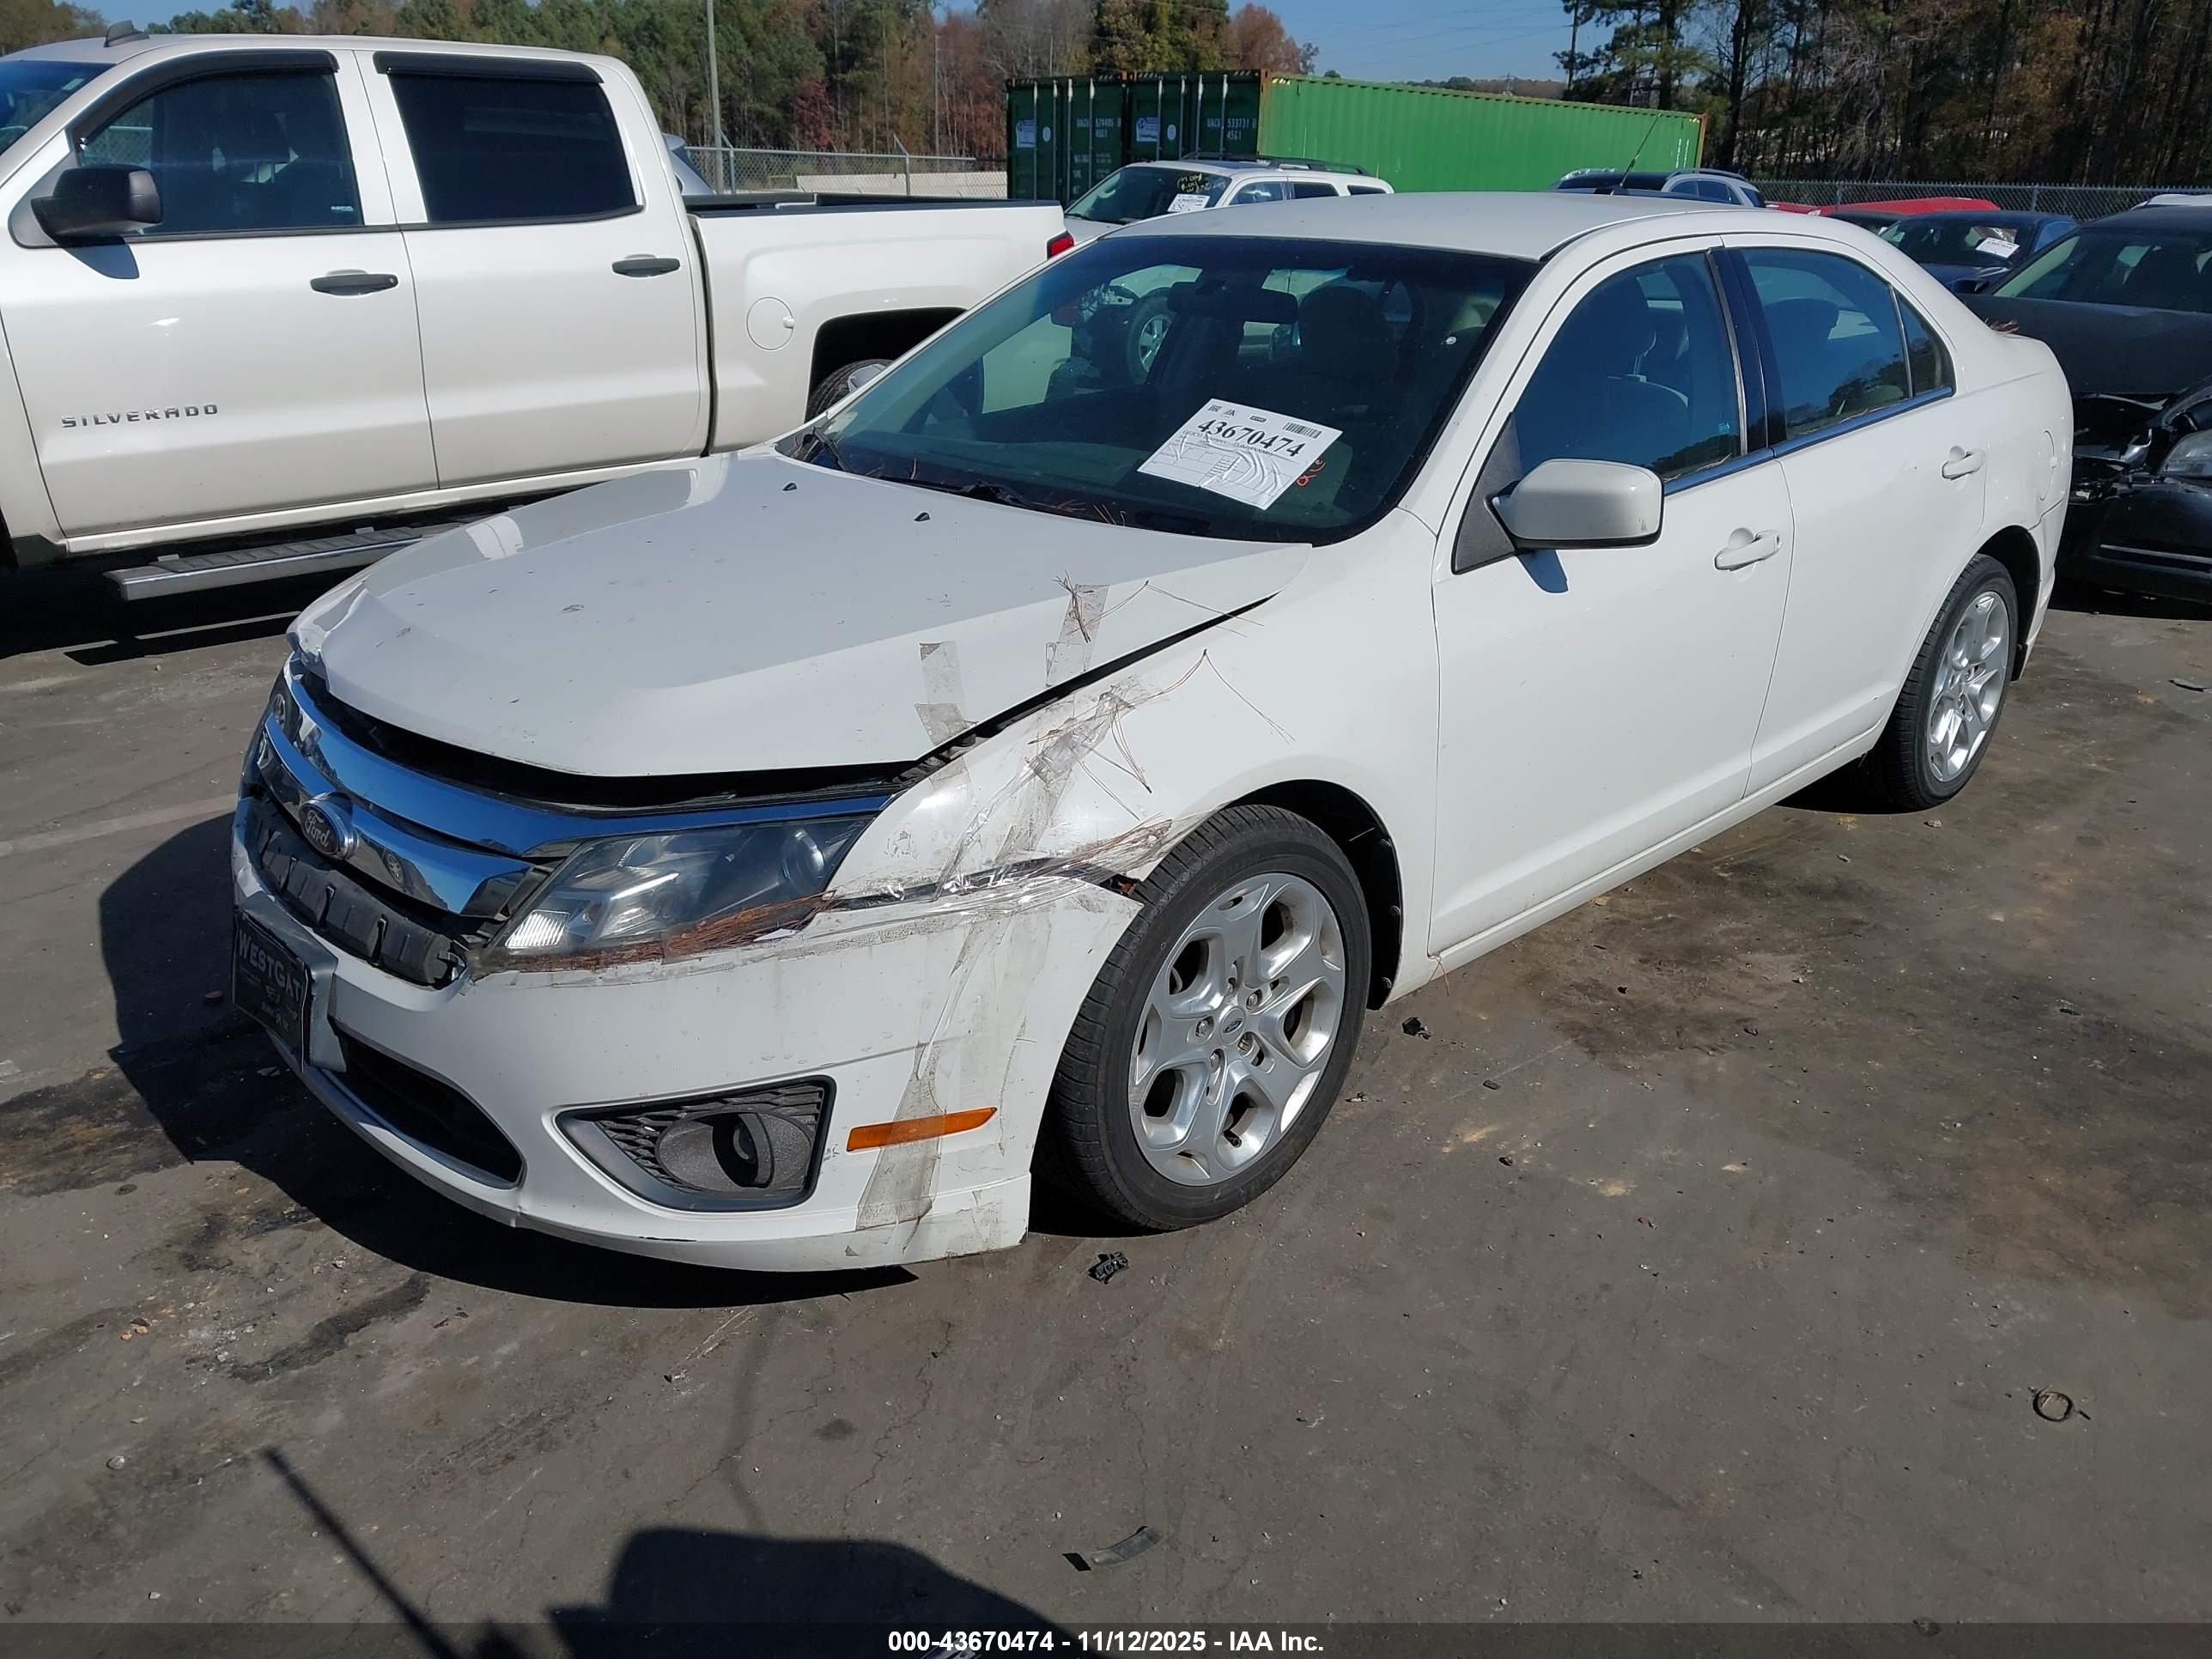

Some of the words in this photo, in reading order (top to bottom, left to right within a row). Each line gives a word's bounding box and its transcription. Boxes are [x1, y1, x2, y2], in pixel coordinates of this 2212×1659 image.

[61, 404, 218, 428] SILVERADO
[1198, 419, 1306, 457] 43670474
[305, 810, 331, 848] Ford
